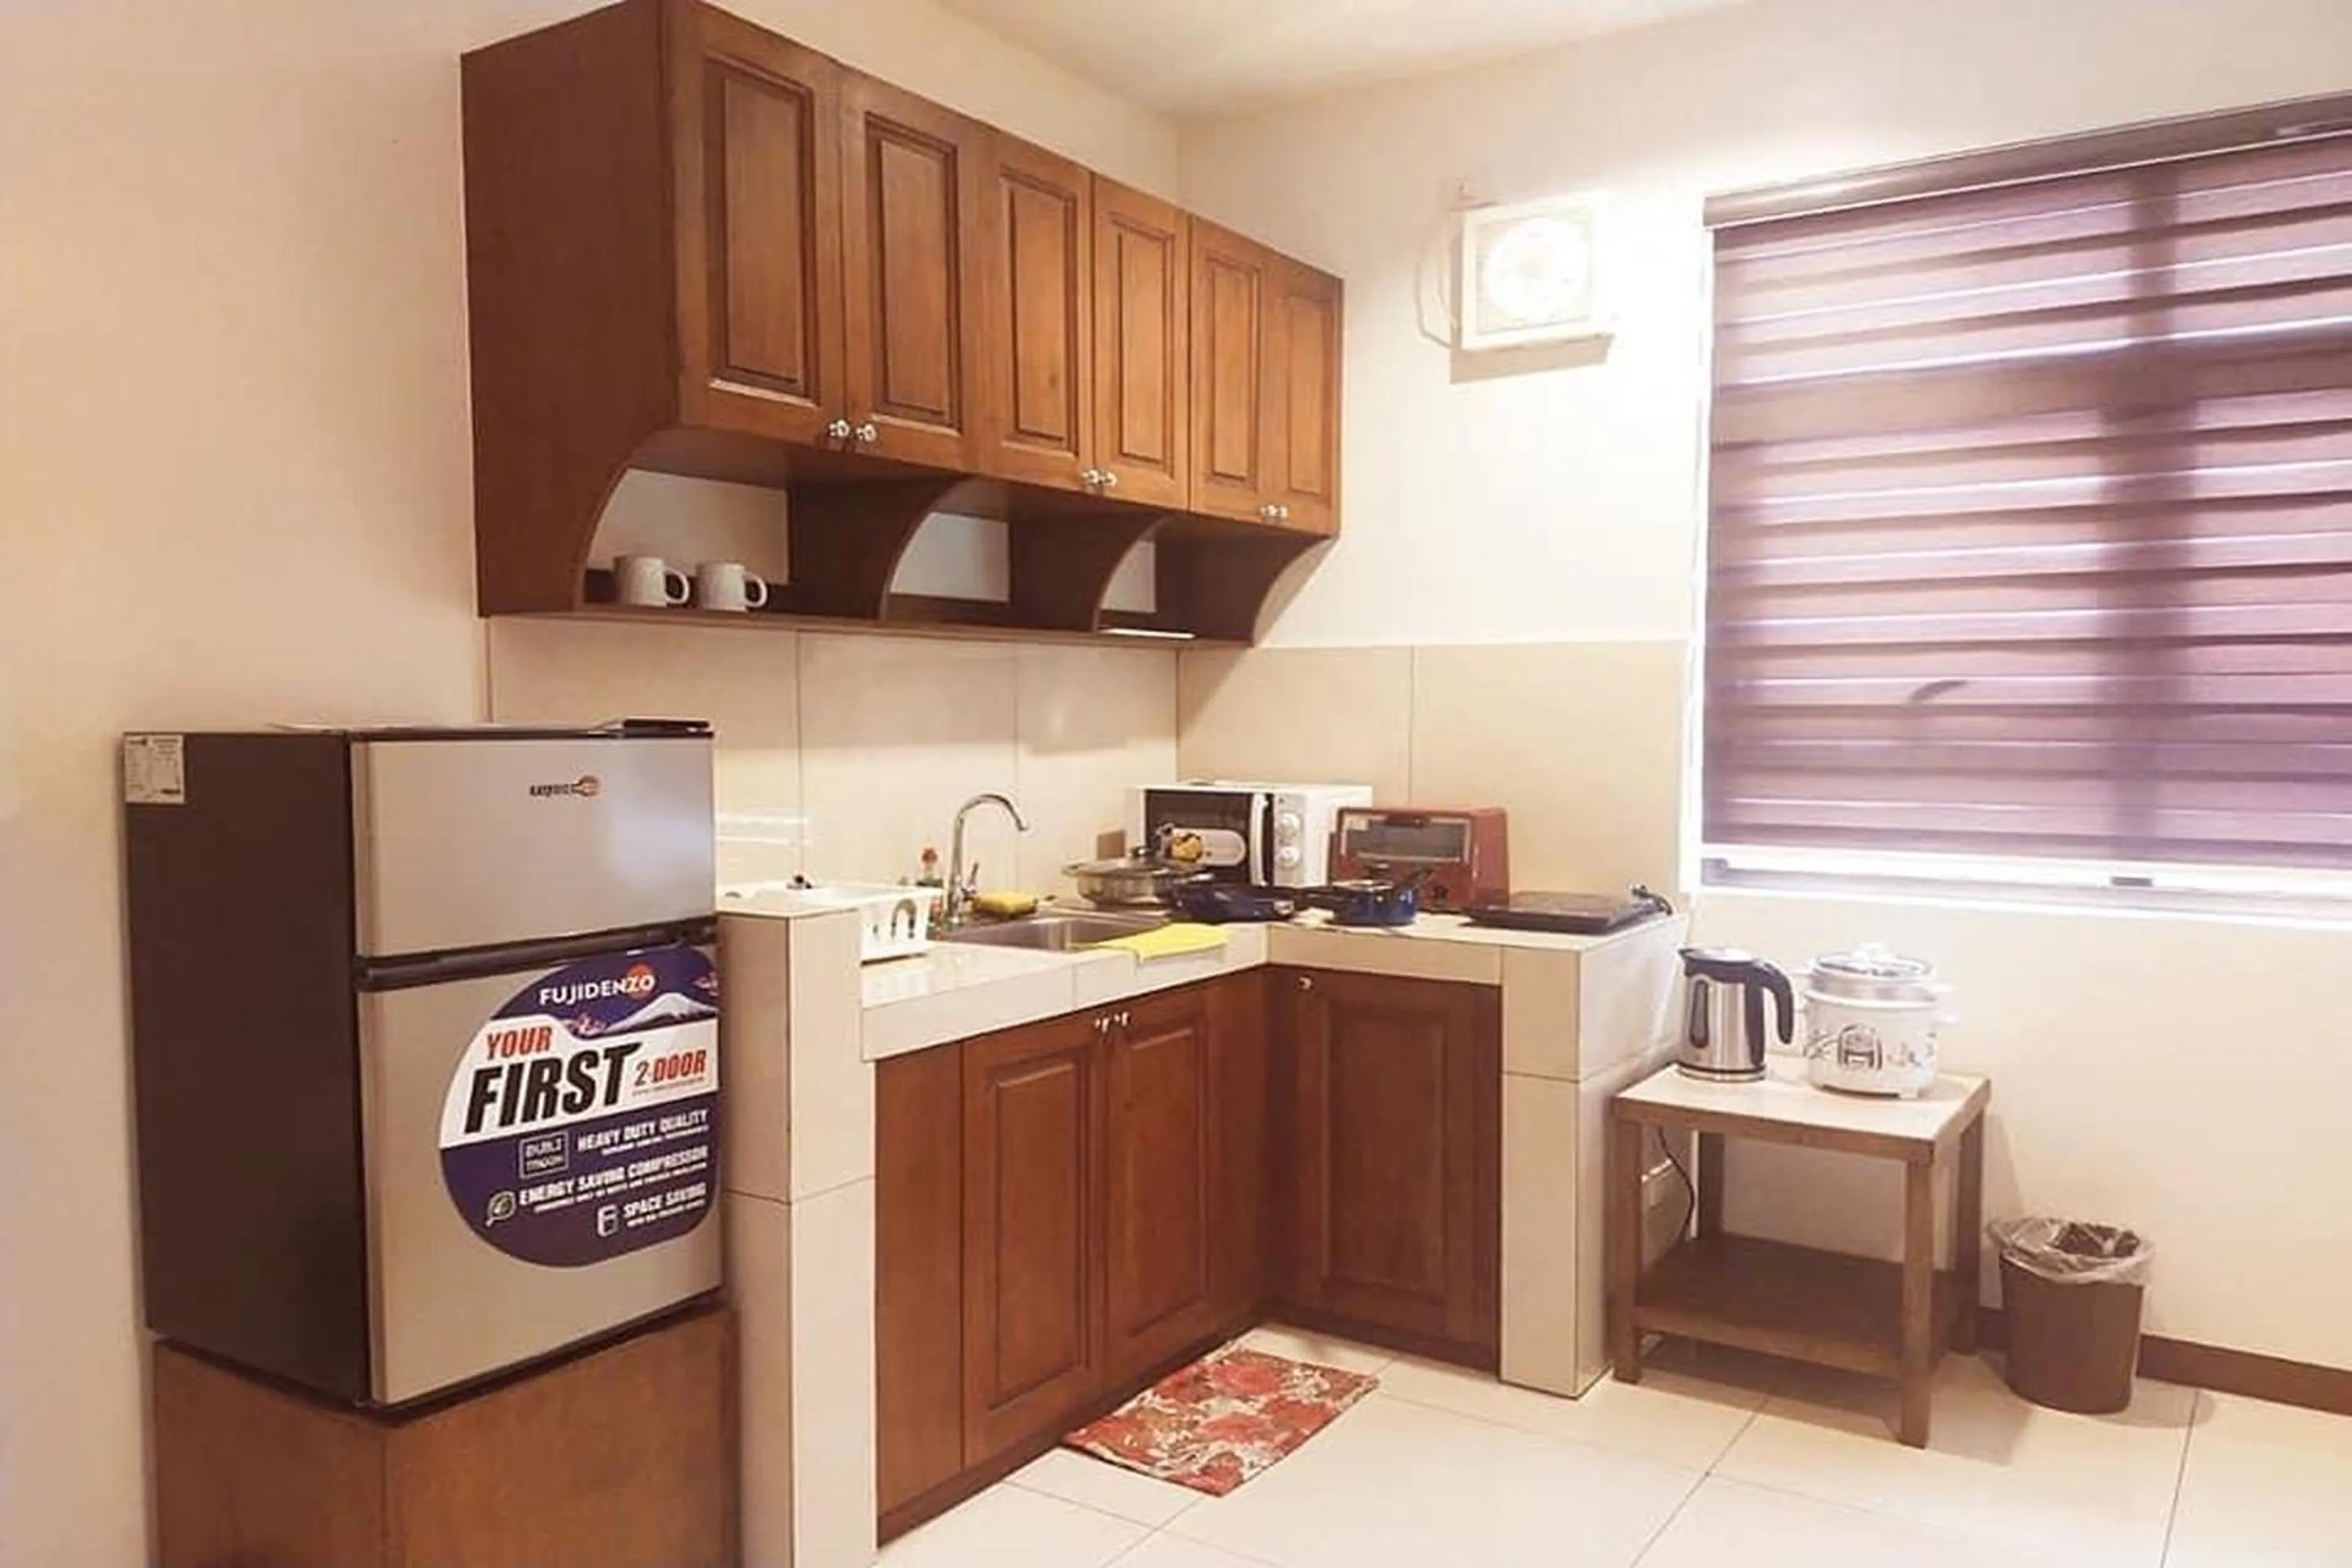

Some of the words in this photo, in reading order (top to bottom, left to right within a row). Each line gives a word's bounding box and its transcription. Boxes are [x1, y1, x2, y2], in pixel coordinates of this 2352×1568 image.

[539, 975, 655, 1005] FUJIDENZO
[487, 1026, 553, 1059] YOUR
[464, 1043, 642, 1134] FIRST
[578, 1129, 621, 1151] HEAVY
[624, 1121, 655, 1140] DUTY
[659, 1109, 708, 1134] QUALITY
[520, 1179, 575, 1205] ENERGY
[578, 1167, 626, 1190] SAVING
[628, 1145, 708, 1178] COMPRESSOR
[623, 1195, 663, 1218] SPACE
